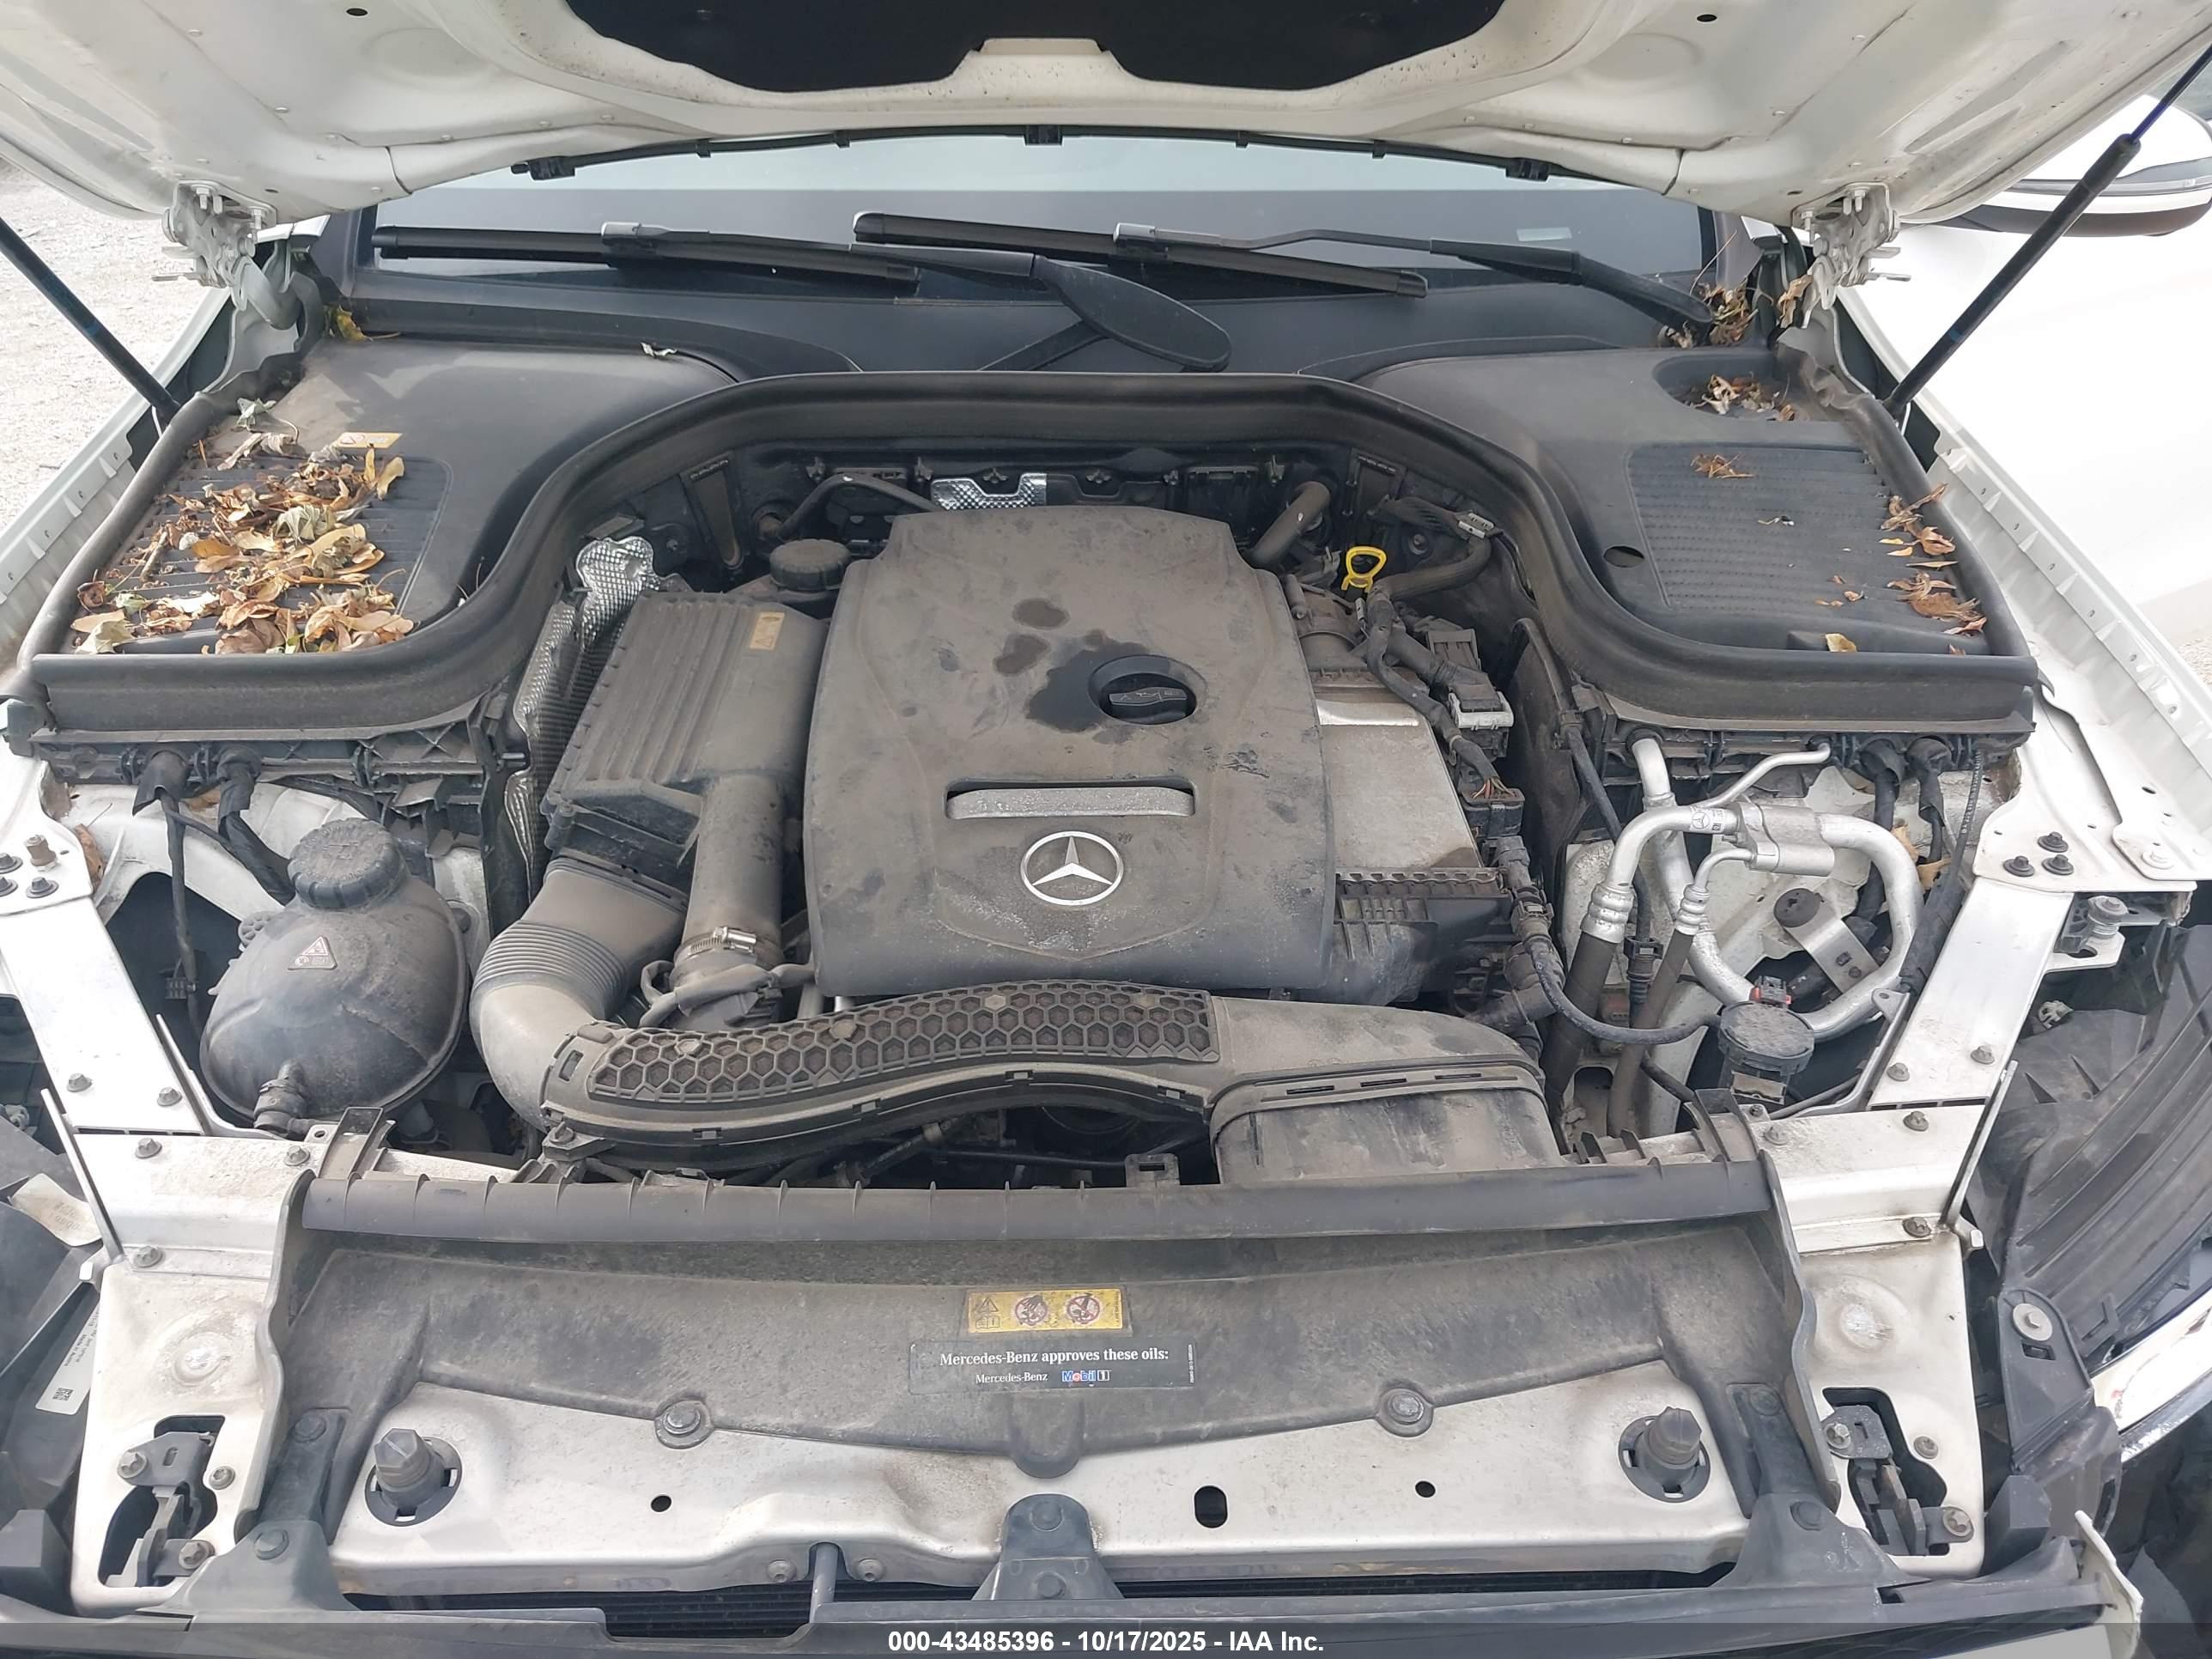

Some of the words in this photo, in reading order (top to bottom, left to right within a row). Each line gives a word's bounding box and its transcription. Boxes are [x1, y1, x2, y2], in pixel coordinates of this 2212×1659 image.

[939, 1351, 1038, 1366] Mercedes-Benz
[1042, 1350, 1100, 1365] approves
[1103, 1348, 1139, 1361] these
[1141, 1347, 1169, 1360] oils:
[975, 1371, 1048, 1384] Mercedes-Benz
[1062, 1370, 1096, 1382] Mobil
